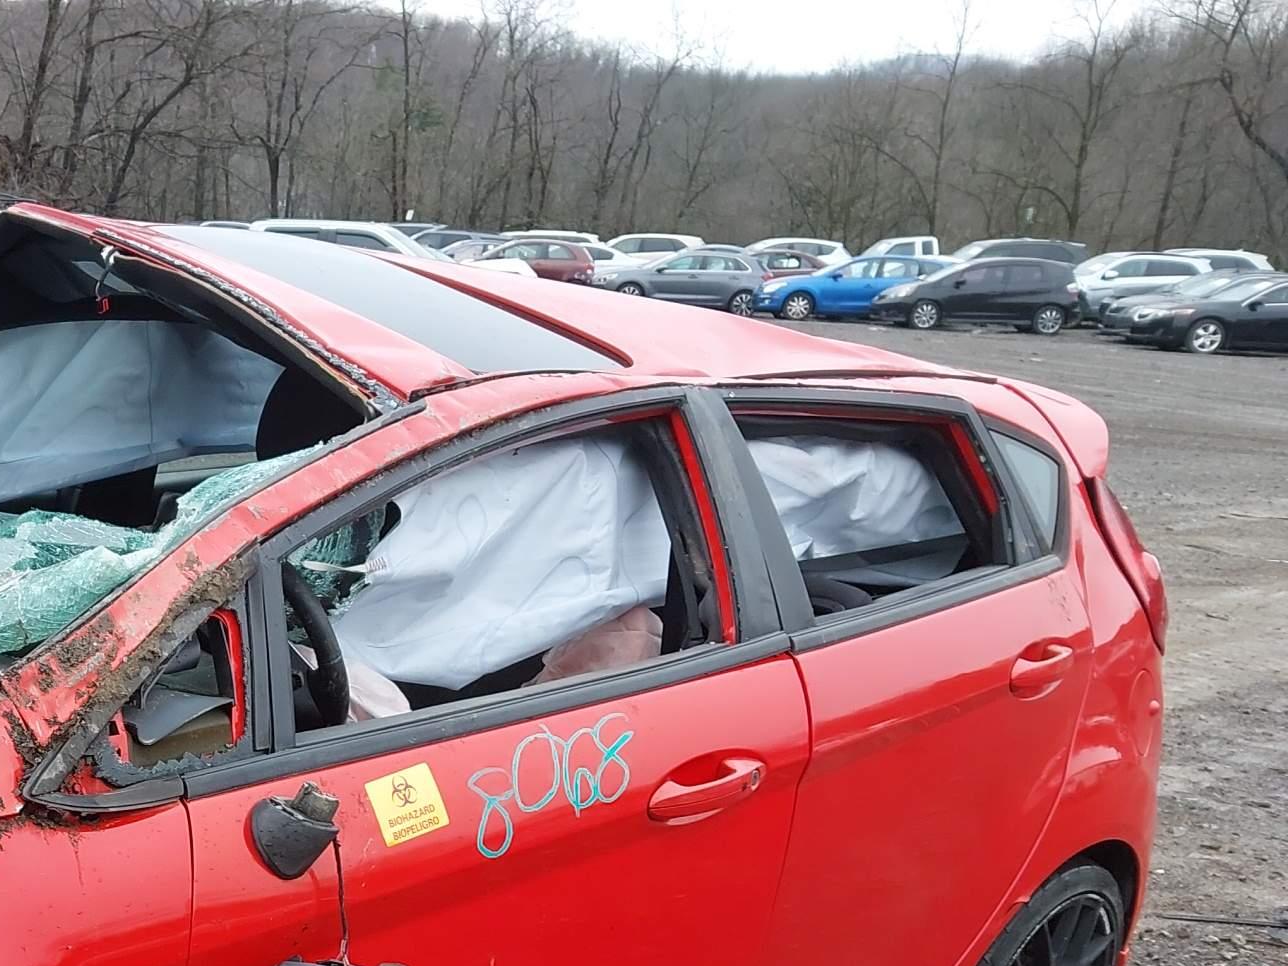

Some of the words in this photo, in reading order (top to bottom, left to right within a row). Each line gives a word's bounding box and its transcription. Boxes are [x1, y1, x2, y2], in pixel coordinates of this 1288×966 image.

[467, 712, 634, 859] 8068
[388, 803, 436, 829] BIOHAZARD
[392, 815, 440, 841] BIOPELIGRO
